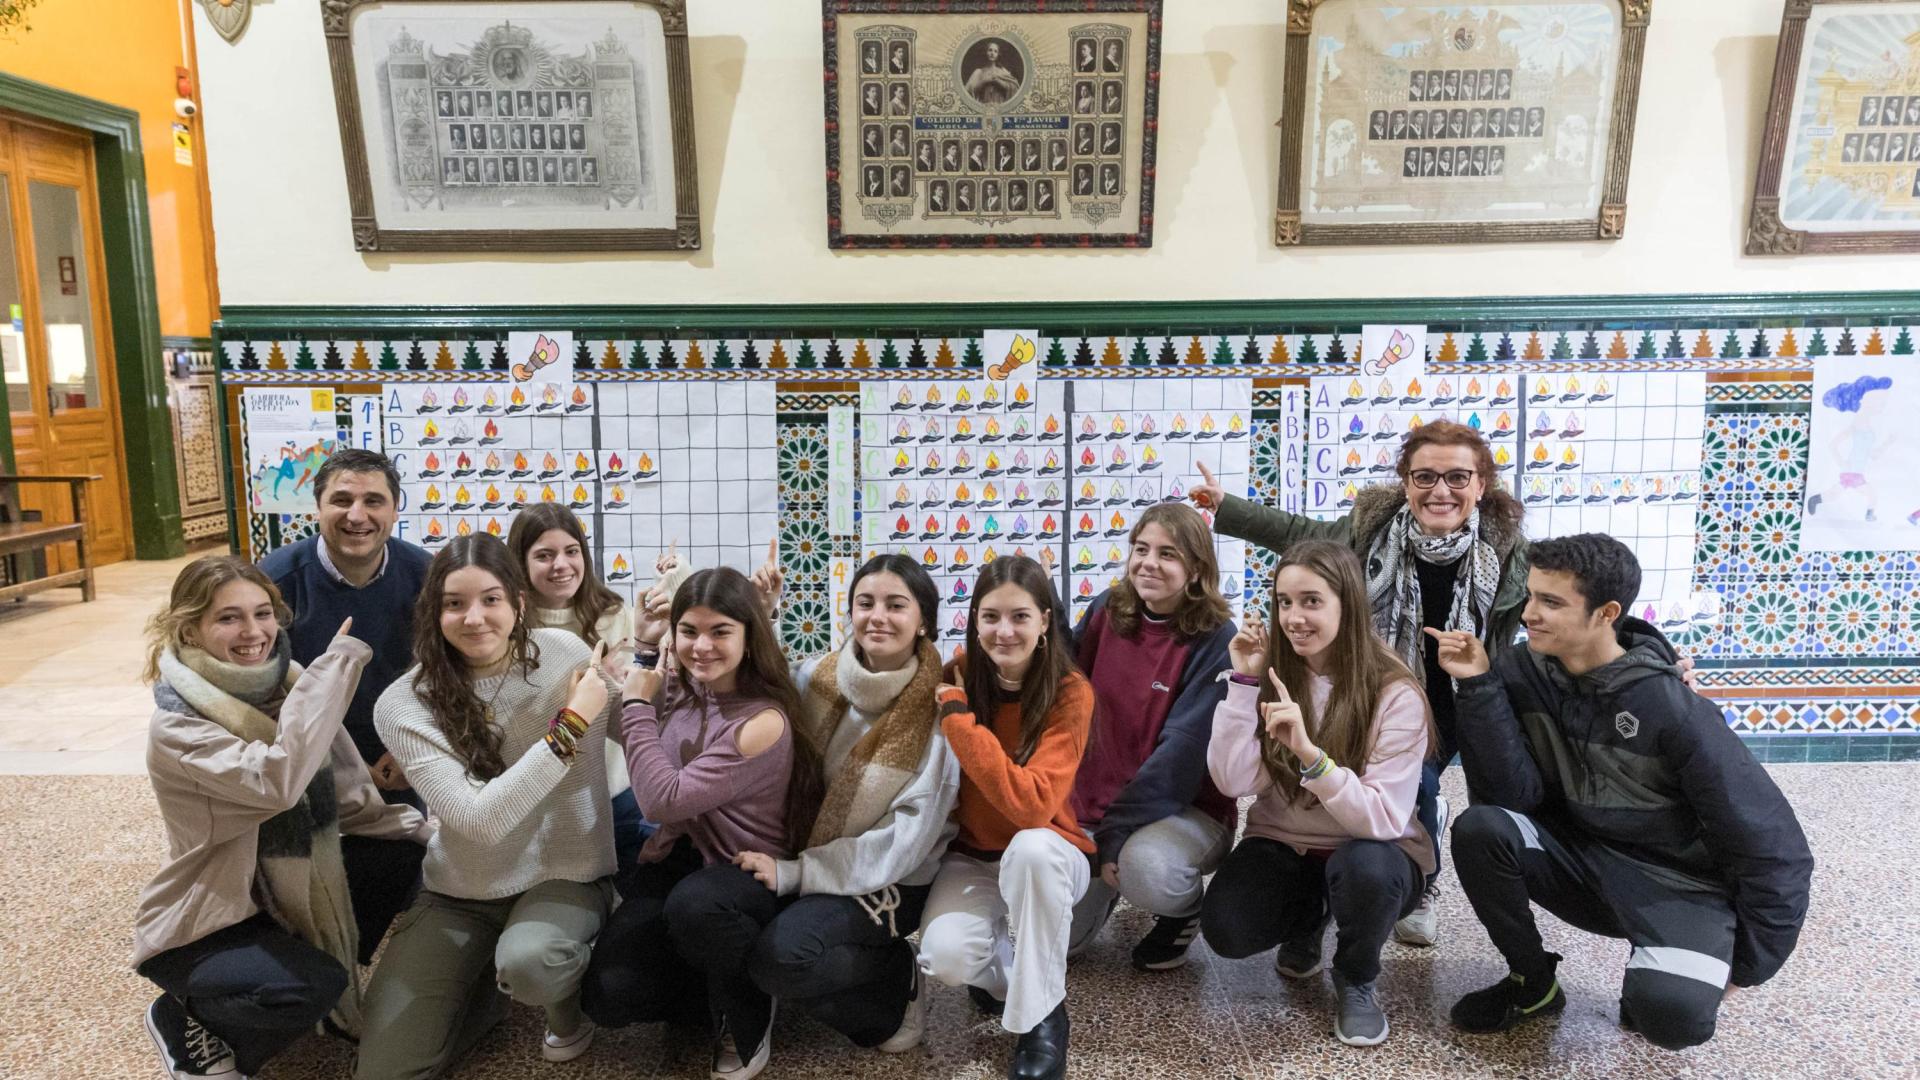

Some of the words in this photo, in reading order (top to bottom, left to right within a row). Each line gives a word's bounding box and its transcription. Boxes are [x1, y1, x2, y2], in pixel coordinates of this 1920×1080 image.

[1027, 115, 1061, 124] JAVIER
[388, 389, 402, 412] A
[864, 384, 877, 410] A
[1316, 384, 1329, 408] A
[390, 422, 404, 445] B
[864, 419, 878, 442] B
[1316, 417, 1330, 439] B
[393, 453, 407, 479] C
[866, 450, 880, 476] C
[1316, 447, 1331, 474] C
[866, 482, 879, 510] D
[1315, 481, 1327, 507] D
[868, 517, 880, 541] E
